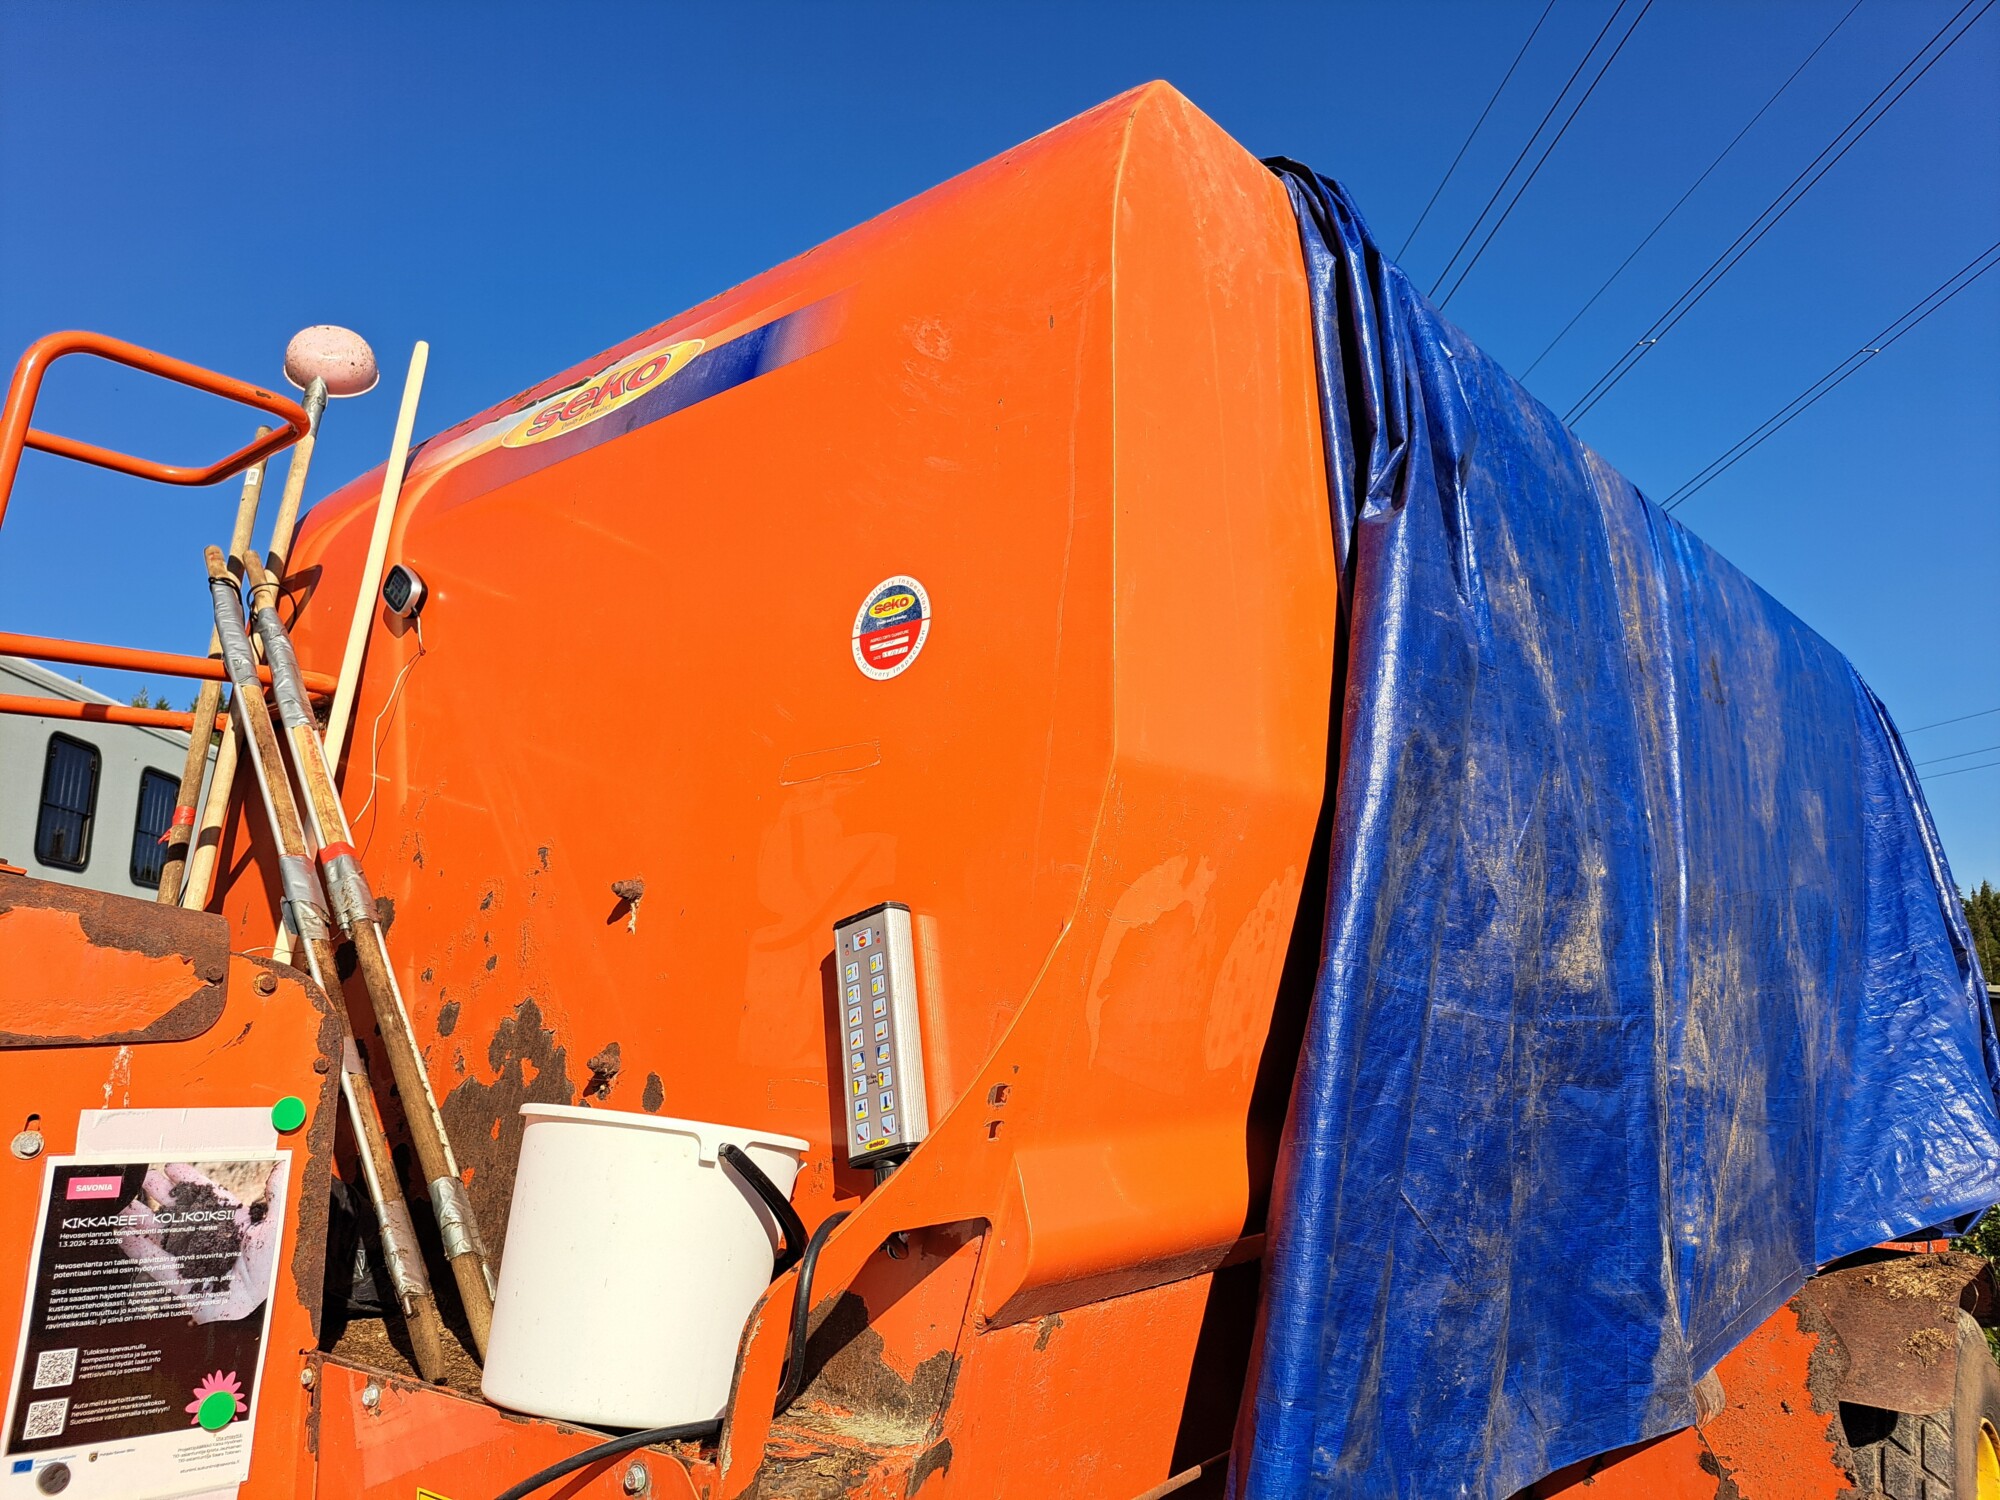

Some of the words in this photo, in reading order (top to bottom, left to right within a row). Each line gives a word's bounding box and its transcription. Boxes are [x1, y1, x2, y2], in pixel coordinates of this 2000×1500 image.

[526, 353, 672, 437] seko
[855, 580, 895, 630] Pre-Delivery
[898, 578, 928, 612] Inspection
[874, 597, 910, 614] seko
[856, 646, 890, 677] Pre-Delivery
[892, 630, 925, 674] Inspection
[62, 1214, 150, 1229] KIKKAREET
[152, 1210, 236, 1224] KOLIKOIKSI!
[60, 1231, 112, 1239] Hevosenlannan
[113, 1228, 156, 1236] kompostointi
[157, 1226, 196, 1234] apevaunulla
[59, 1238, 123, 1248] 1.3.2024-28.2.2026
[54, 1260, 102, 1270] Hevosenlanta
[170, 1254, 195, 1263] syntyvä
[224, 1252, 242, 1260] jonka
[53, 1270, 91, 1280] potentiaali
[68, 1285, 108, 1294] testaamme
[132, 1278, 179, 1289] kompostointia
[48, 1300, 126, 1312] kustannustehokkaasti.
[128, 1296, 172, 1306] Apevaunussa
[172, 1292, 204, 1301] sekoitettu
[69, 1294, 98, 1302] saadaan
[99, 1290, 134, 1300] hajotettua
[136, 1288, 165, 1297] nopeasti
[46, 1312, 88, 1321] kuivikelanta
[90, 1308, 119, 1317] muuttuu
[128, 1304, 159, 1313] kahdessa
[160, 1302, 186, 1310] viikossa
[99, 1318, 106, 1326] ja
[134, 1310, 170, 1321] miellyttävä
[83, 1348, 108, 1356] Tuloksia
[110, 1344, 146, 1354] apevaunulla
[80, 1362, 114, 1372] ravinteista
[82, 1354, 134, 1364] kompostoinnista
[108, 1394, 152, 1404] kartoittamaan
[71, 1406, 120, 1418] hevosenlannan
[120, 1400, 166, 1410] markkinakokoa
[70, 1416, 104, 1426] Suomessa
[104, 1410, 142, 1420] vastaamalla
